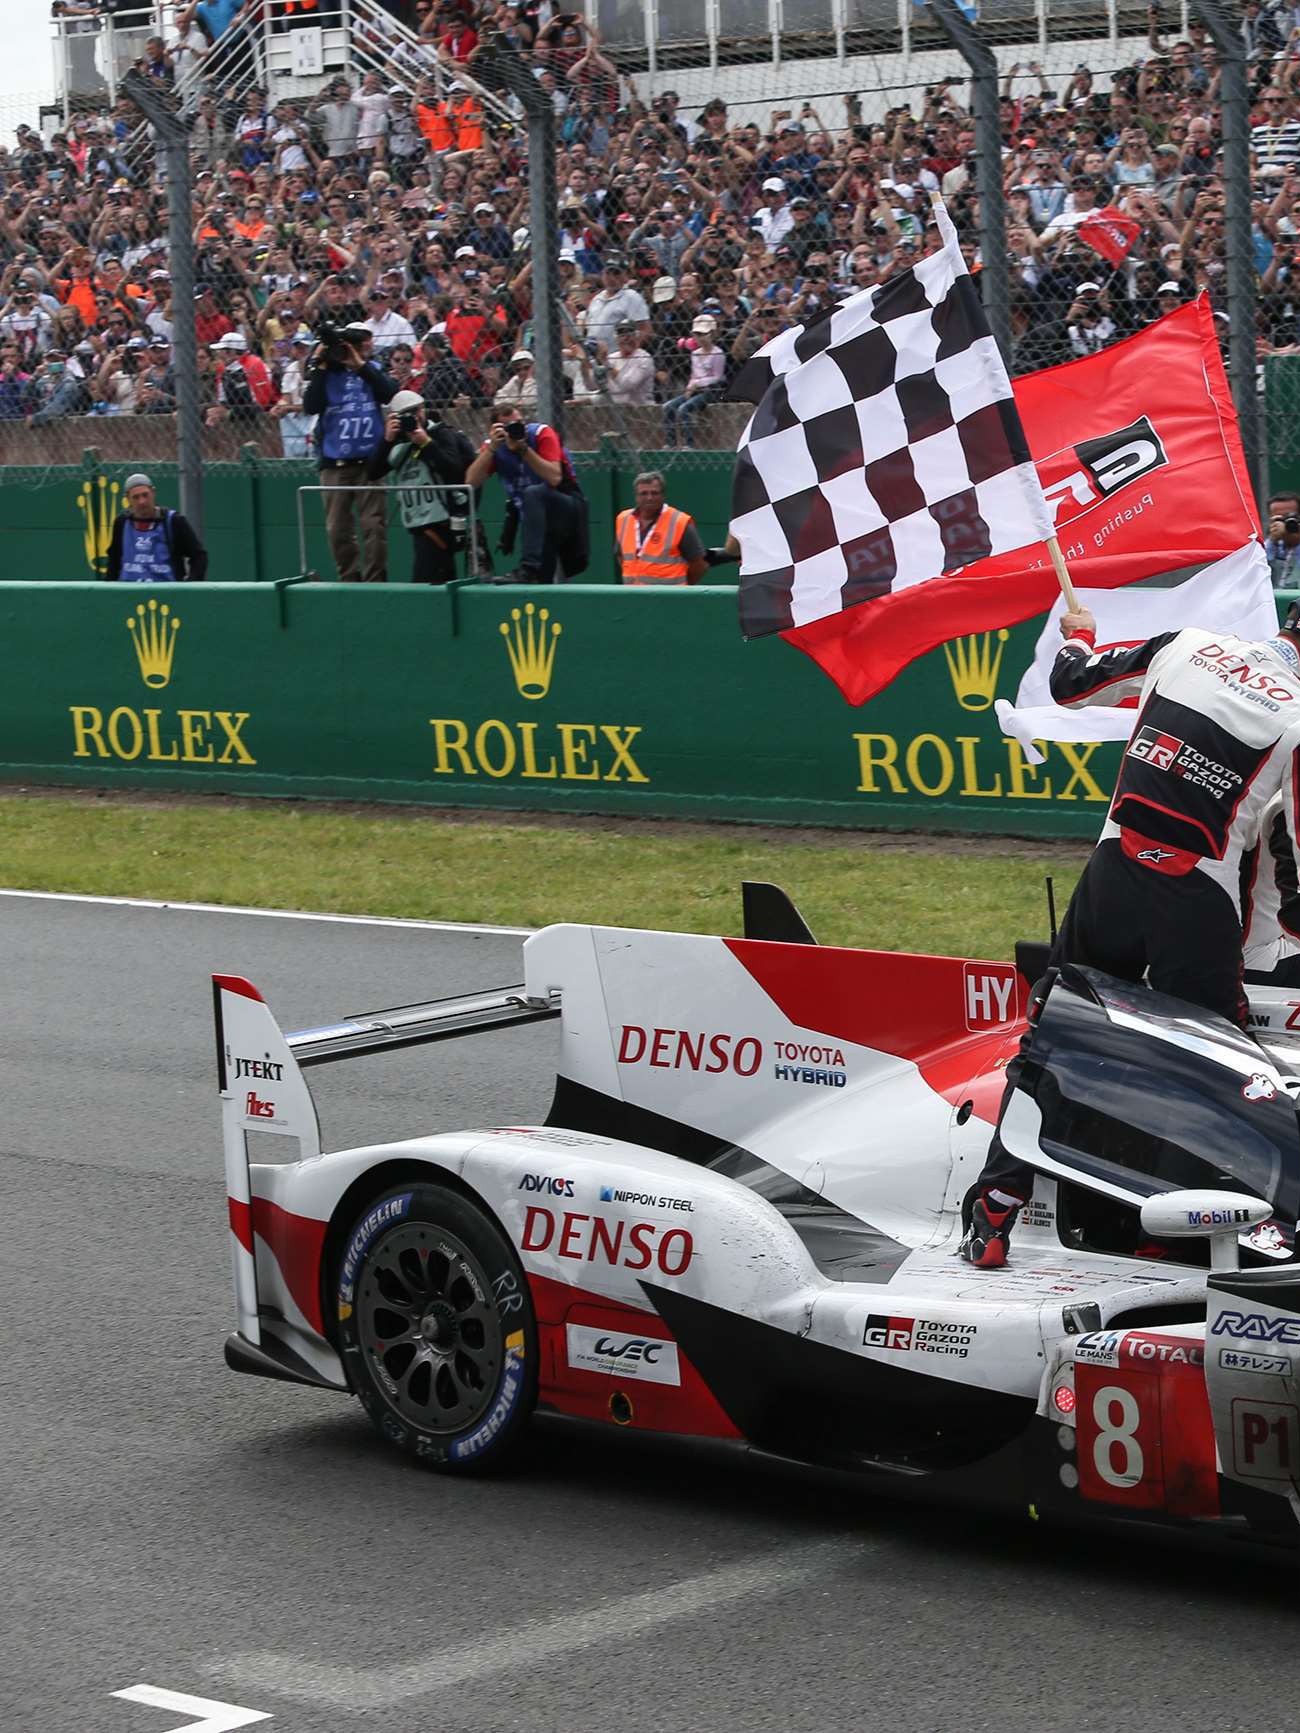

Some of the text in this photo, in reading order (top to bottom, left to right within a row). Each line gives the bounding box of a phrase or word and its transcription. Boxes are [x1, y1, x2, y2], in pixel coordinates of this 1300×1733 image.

[339, 417, 373, 439] 272
[1189, 654, 1229, 684] TOYOTA
[1196, 643, 1294, 702] DENSO
[1227, 681, 1281, 713] HYBRID
[69, 706, 257, 765] ROLEX
[429, 719, 649, 783] ROLEX
[853, 733, 1111, 801] ROLEX
[1131, 738, 1175, 767] GR
[1184, 745, 1243, 785] TOYOTA
[1173, 765, 1225, 799] Racing
[1177, 756, 1232, 790] GAZOO
[966, 975, 1013, 1022] HY
[618, 1024, 763, 1077] DENSO
[774, 1041, 845, 1066] TOYOTA
[235, 1058, 283, 1081] JTEKT
[775, 1064, 847, 1088] HYBRID
[518, 1174, 695, 1212] ADVICS NIPPON STEEL
[1188, 1211, 1232, 1225] Mobil
[346, 1198, 404, 1279] MICHELIN
[521, 1206, 694, 1276] DENSO
[864, 1327, 911, 1351] GR
[916, 1331, 971, 1345] GAZOO
[918, 1320, 978, 1334] TOYOTA
[594, 1337, 663, 1364] WEC
[915, 1341, 969, 1358] Racing
[1075, 1349, 1087, 1357] LE
[1087, 1349, 1114, 1361] MANS
[1225, 1352, 1289, 1372] 林テレンプ
[1092, 1386, 1144, 1488] 8
[1243, 1412, 1290, 1468] P1
